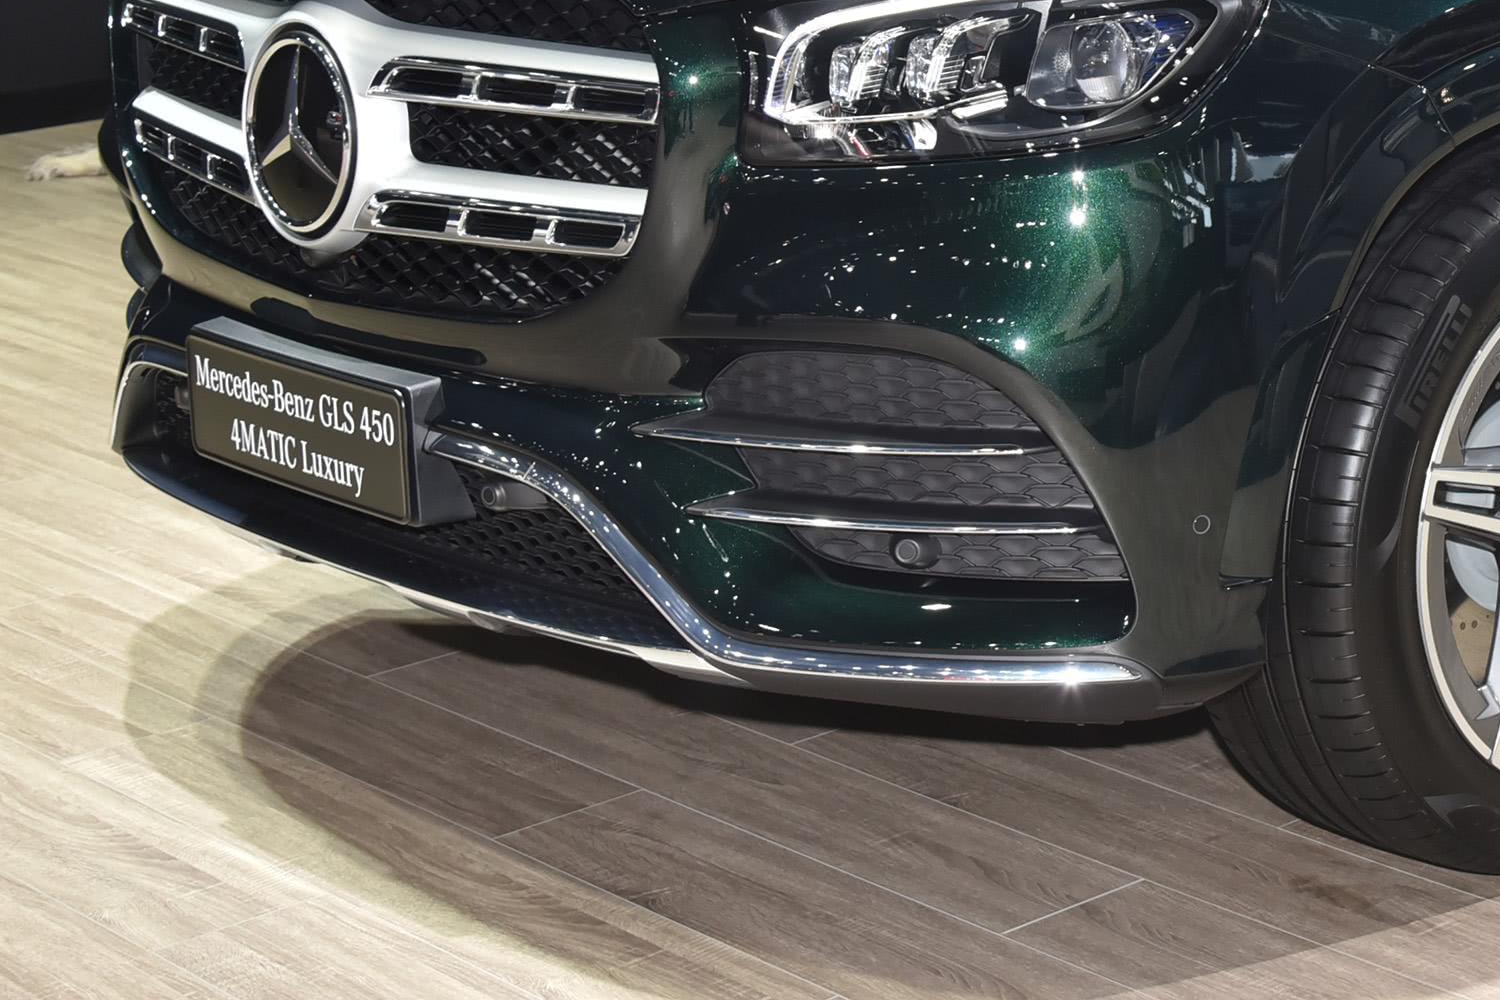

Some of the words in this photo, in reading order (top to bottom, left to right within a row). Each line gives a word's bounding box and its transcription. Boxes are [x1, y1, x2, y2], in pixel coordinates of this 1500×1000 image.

[194, 355, 315, 423] Mercedes-Benz
[319, 394, 355, 435] GLS
[360, 406, 395, 446] 450
[230, 418, 297, 469] 4MATIC
[301, 440, 365, 498] Luxury
